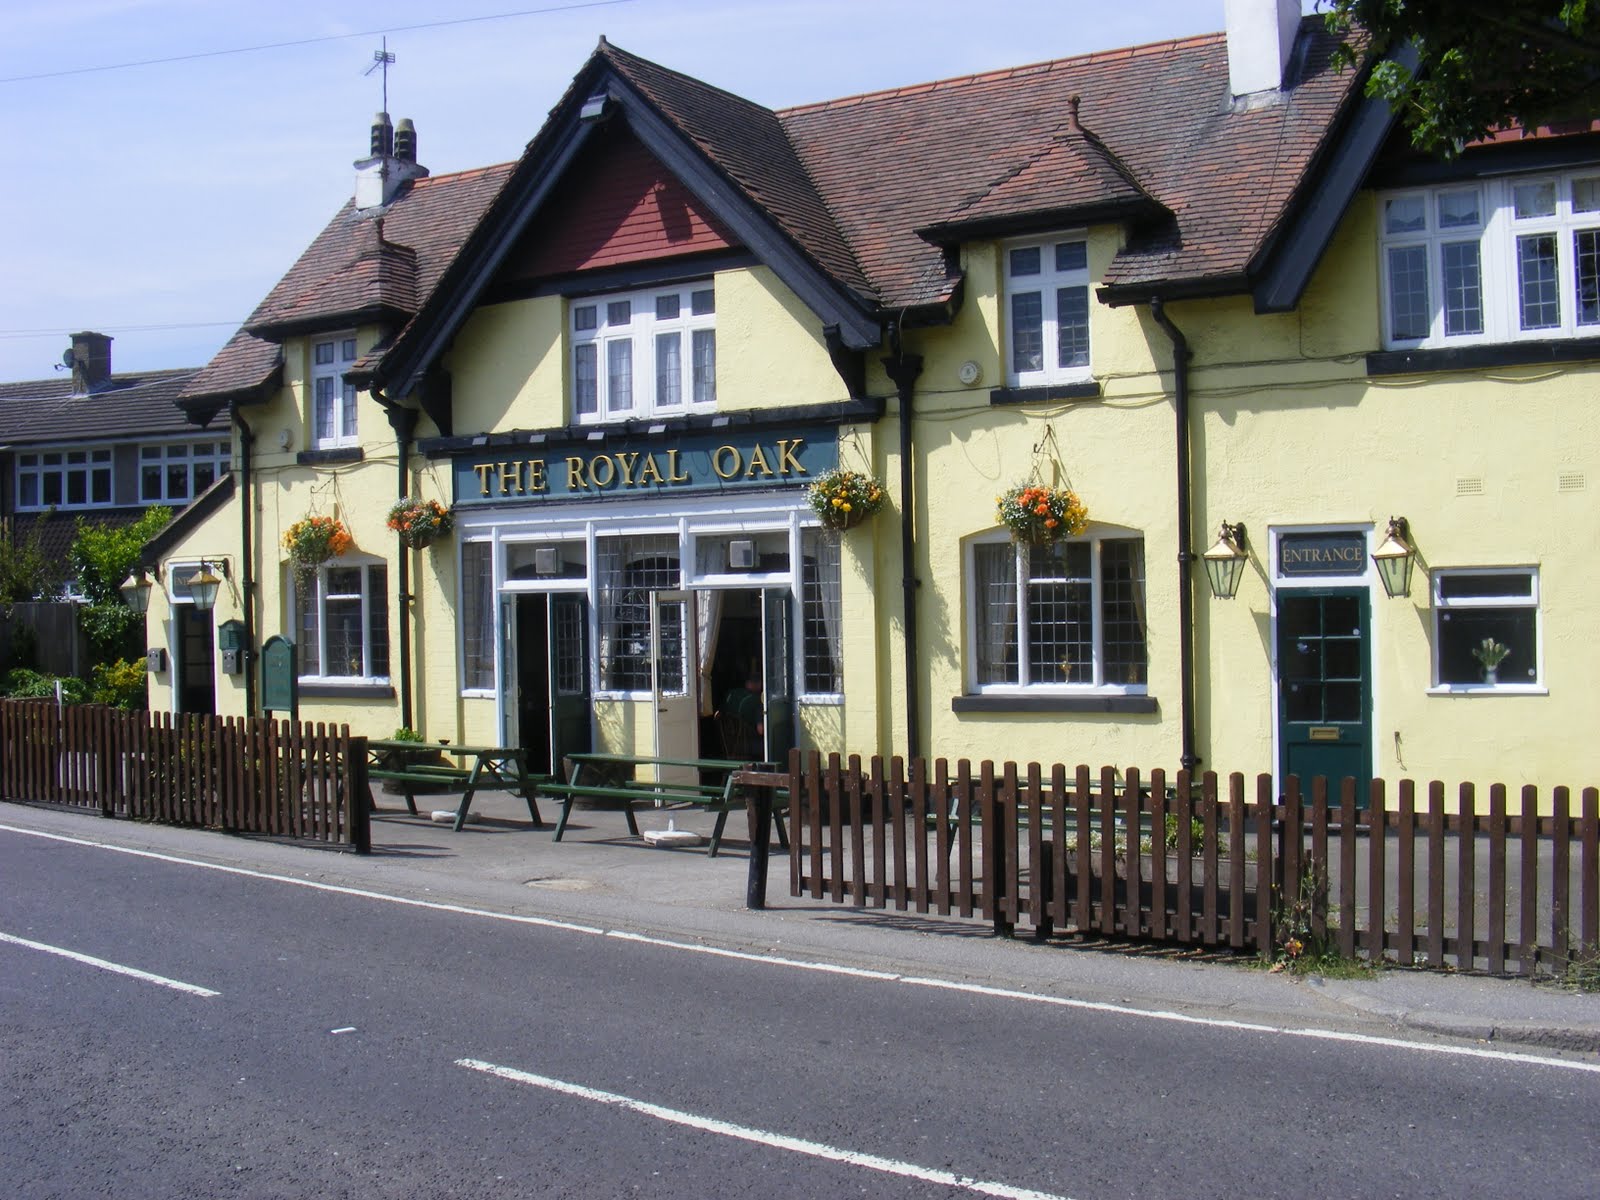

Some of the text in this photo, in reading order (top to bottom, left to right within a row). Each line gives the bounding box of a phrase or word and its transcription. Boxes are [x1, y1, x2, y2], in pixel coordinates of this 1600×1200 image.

[473, 438, 807, 494] THE ROYAL OAK
[1283, 547, 1363, 562] ENTRANCE
